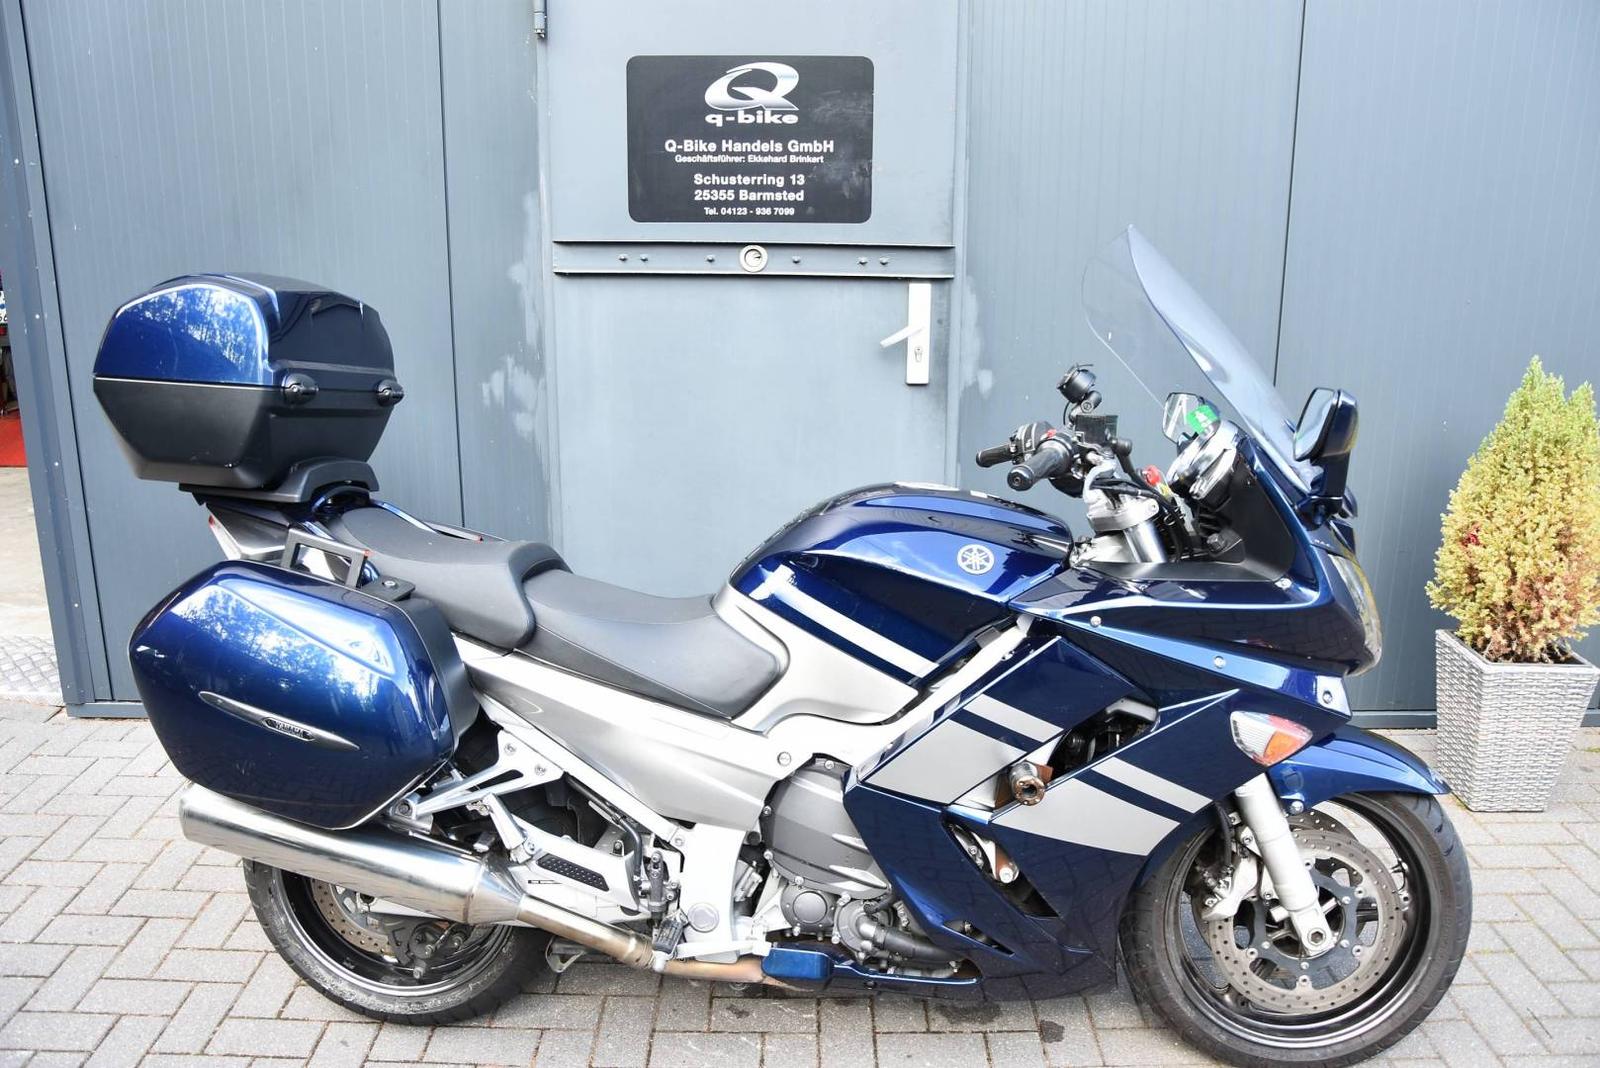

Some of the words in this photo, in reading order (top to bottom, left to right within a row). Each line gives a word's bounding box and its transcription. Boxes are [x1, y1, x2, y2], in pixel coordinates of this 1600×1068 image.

[705, 110, 799, 127] q-bike
[664, 139, 717, 153] Q-Bike
[721, 140, 783, 152] Handels
[787, 140, 835, 152] GmbH
[674, 154, 746, 163] Geschäftsführer:
[747, 154, 788, 163] Ekkehard
[789, 154, 824, 163] Brinkert
[693, 173, 785, 187] Schusterring
[789, 174, 805, 186] 13
[694, 189, 735, 201] 25355
[739, 189, 805, 201] Barmsted
[704, 207, 719, 216] Tel.
[720, 207, 748, 216] 04123
